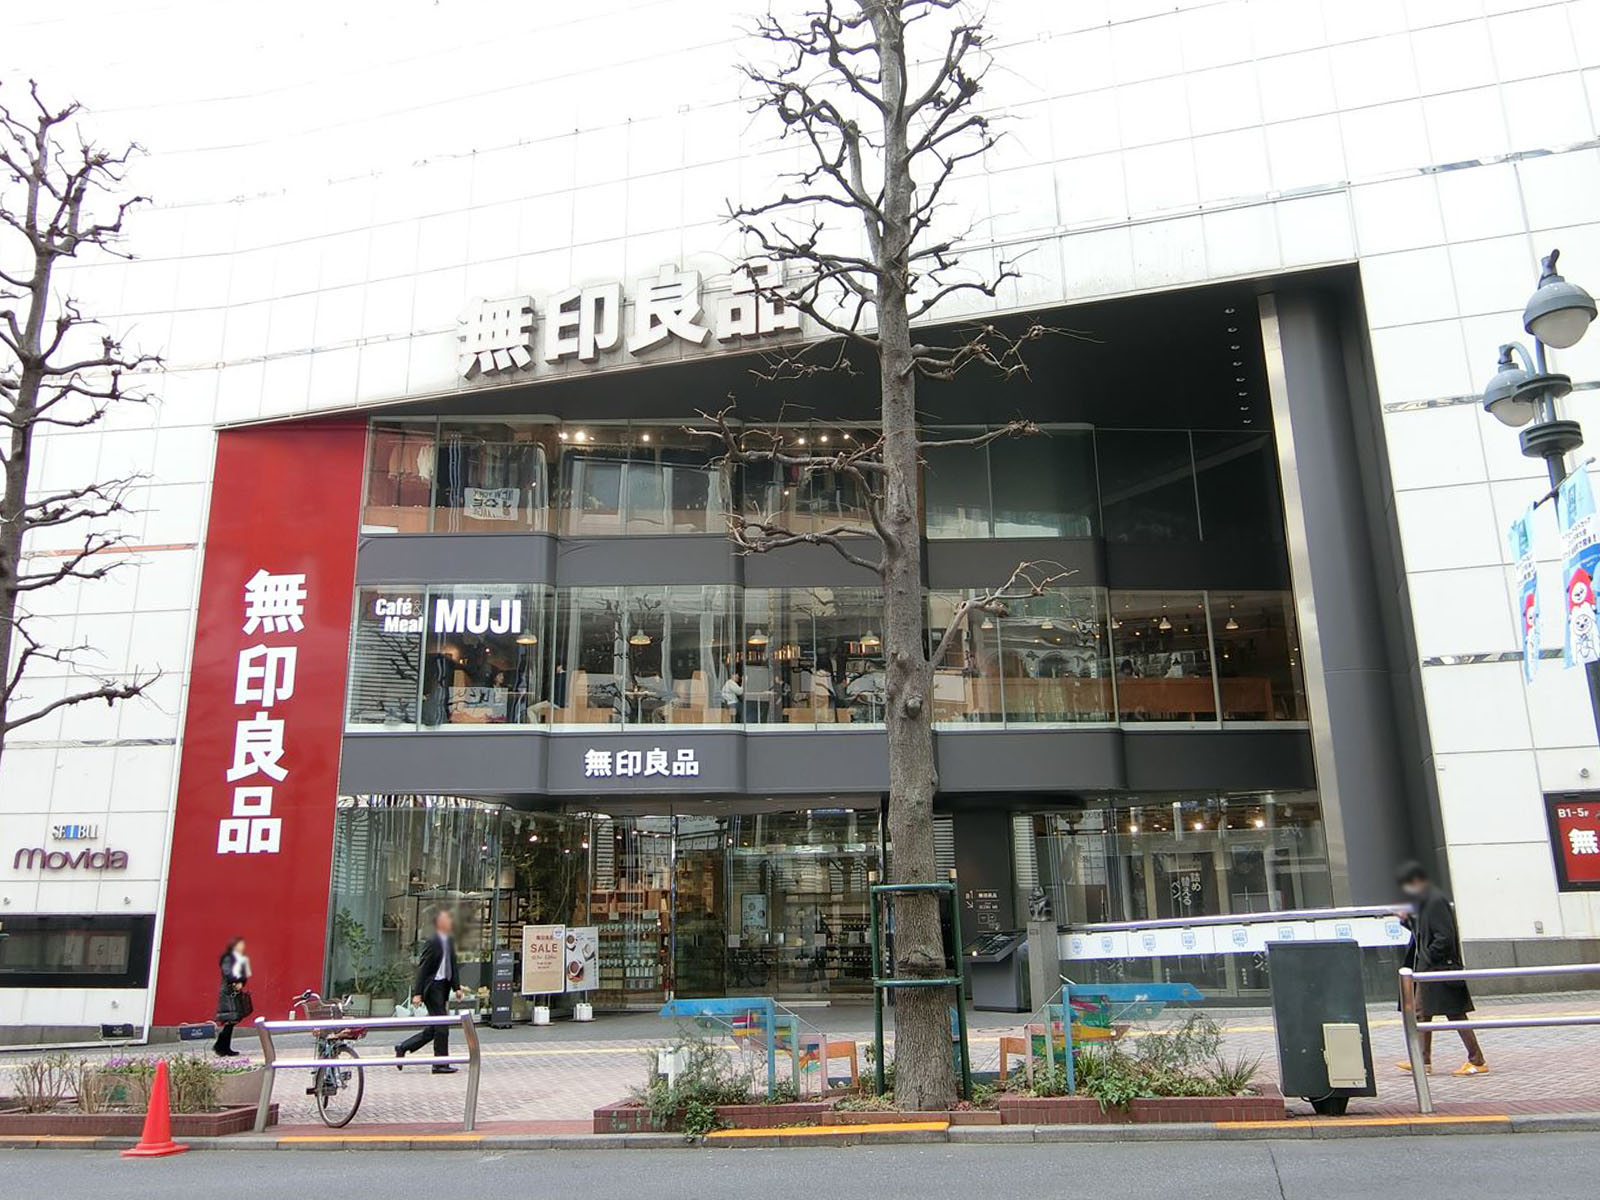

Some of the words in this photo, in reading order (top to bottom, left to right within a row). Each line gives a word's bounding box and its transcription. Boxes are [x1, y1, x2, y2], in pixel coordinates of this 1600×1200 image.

[456, 261, 804, 381] 無印良品
[375, 597, 412, 616] Café
[434, 598, 523, 635] MUJI
[383, 616, 424, 633] Meal
[217, 568, 307, 854] 無印良品
[584, 747, 700, 777] 無印良品
[52, 824, 99, 840] SEIBU
[1567, 827, 1600, 856] 無
[13, 847, 129, 871] movida
[530, 943, 559, 953] SALE
